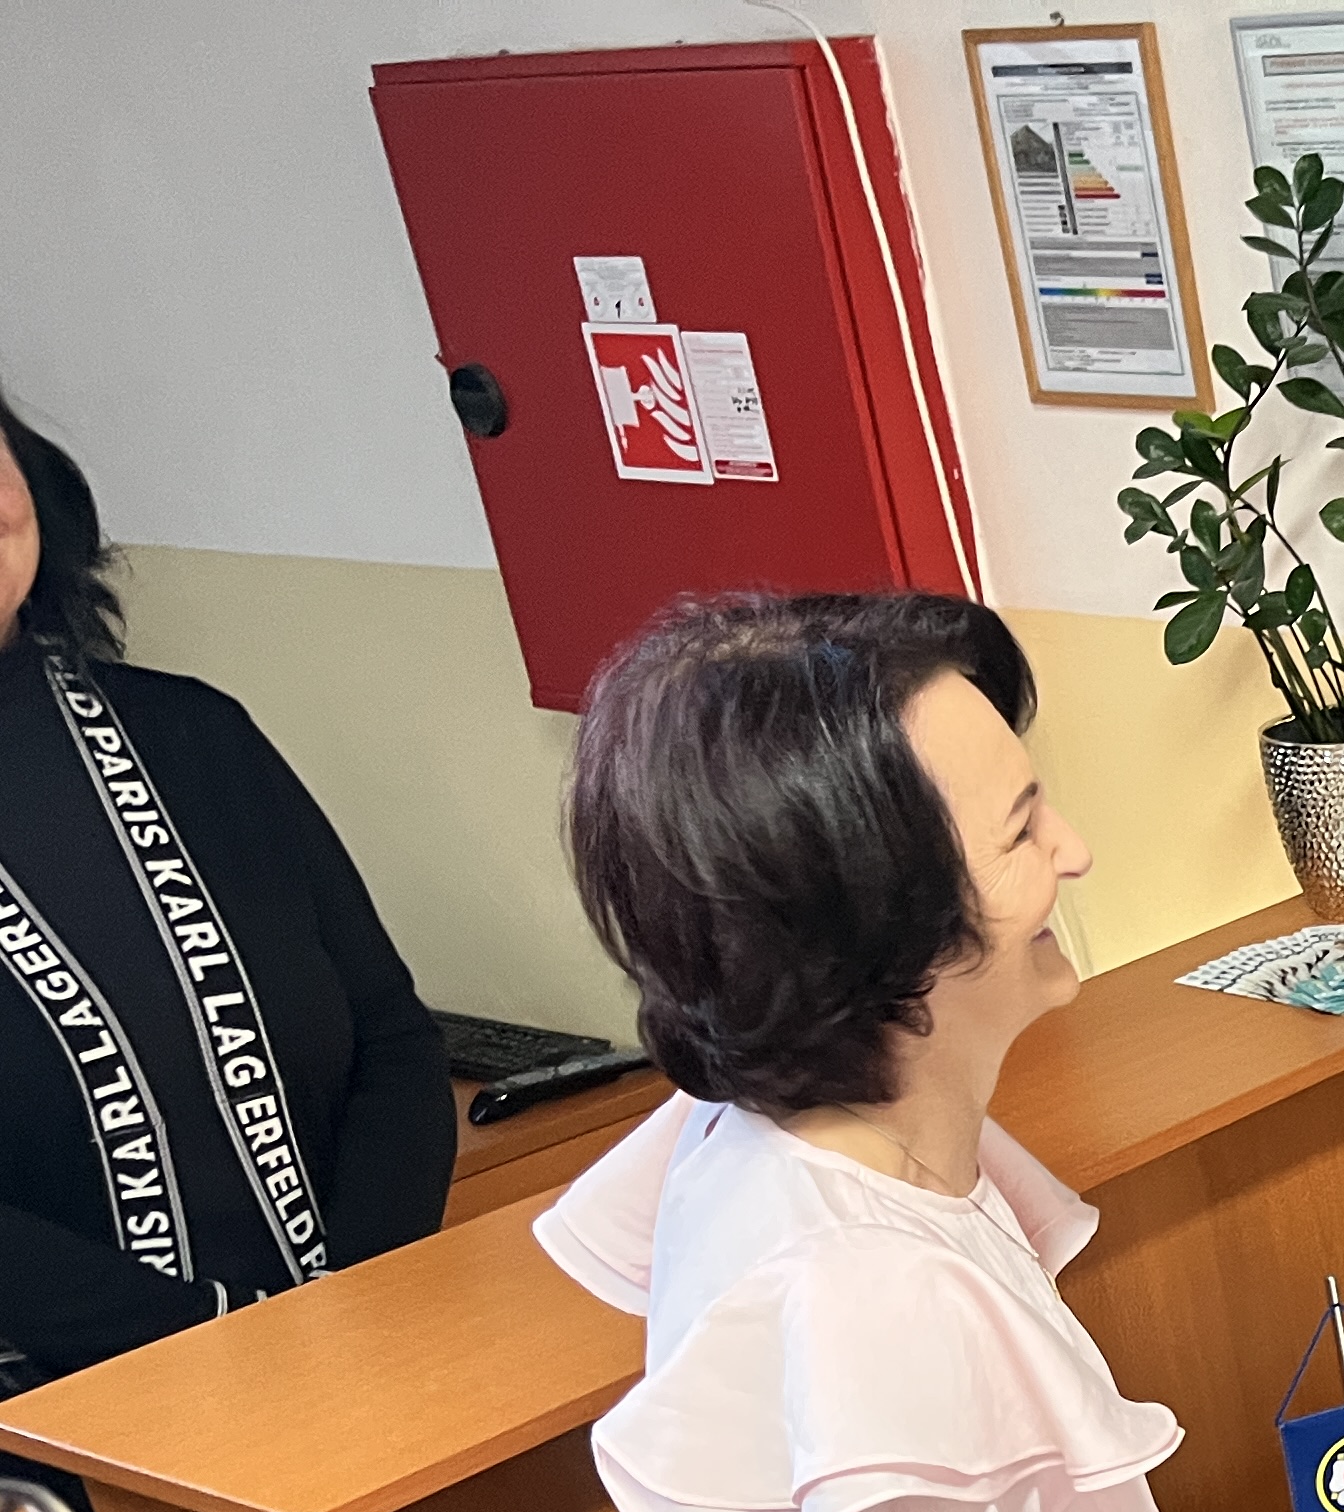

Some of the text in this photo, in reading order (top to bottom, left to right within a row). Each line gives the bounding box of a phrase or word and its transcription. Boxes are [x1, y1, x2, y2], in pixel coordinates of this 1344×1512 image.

[82, 727, 169, 847] PARIS
[145, 859, 229, 982] KARL
[93, 1066, 163, 1200] KARL
